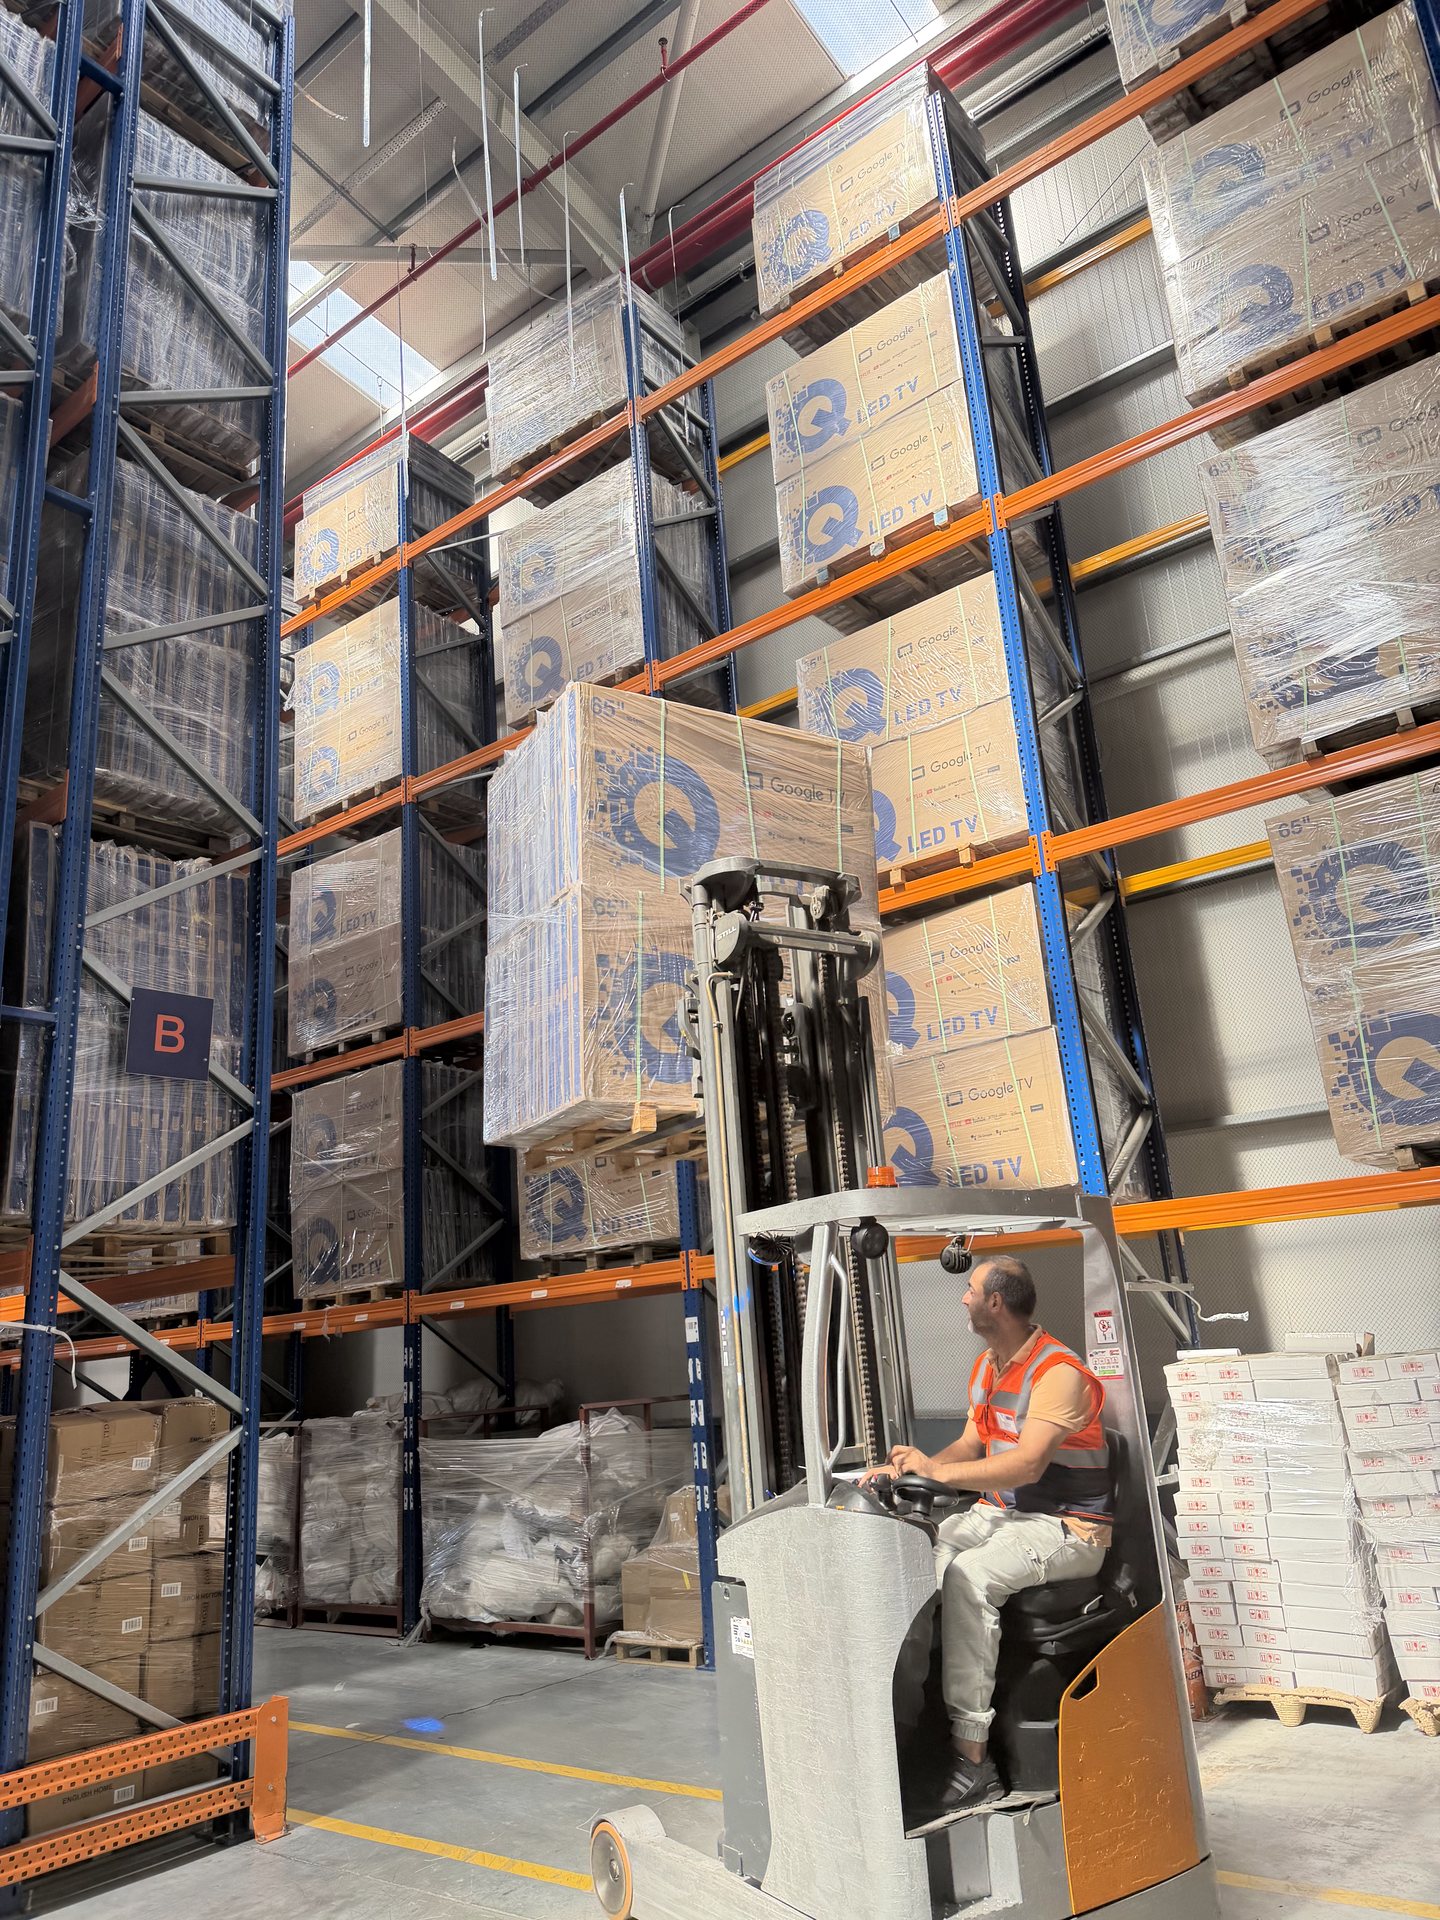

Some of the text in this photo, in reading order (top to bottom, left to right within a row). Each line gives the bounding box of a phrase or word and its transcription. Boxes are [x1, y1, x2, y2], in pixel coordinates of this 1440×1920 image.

[1307, 68, 1363, 104] Google
[857, 150, 893, 181] Google
[1337, 177, 1422, 228] Google TV
[1312, 280, 1365, 320] LED
[1370, 260, 1409, 289] TV
[876, 323, 914, 352] Google
[855, 392, 892, 425] LED
[894, 375, 919, 401] TV
[889, 433, 929, 461] Google
[868, 505, 904, 537] LED
[907, 489, 933, 514] TV
[916, 624, 959, 650] Google
[591, 696, 625, 718] 65"
[893, 698, 932, 726] LED
[935, 682, 963, 709] TV
[358, 720, 382, 737] Google
[930, 741, 992, 775] Google TV
[770, 776, 824, 802] Google
[907, 814, 978, 854] LED TV
[1277, 816, 1312, 839] 65"
[361, 909, 378, 927] TV
[716, 926, 737, 942] STILL
[154, 1013, 185, 1054] B
[926, 1015, 966, 1041] LED
[970, 1005, 998, 1030] TV
[968, 1075, 1033, 1102] Google TV
[946, 1162, 989, 1188] LED
[992, 1155, 1022, 1180] TV
[344, 1261, 366, 1280] LED
[367, 1259, 382, 1275] TV
[62, 1783, 115, 1805] ENGLISH HOME
